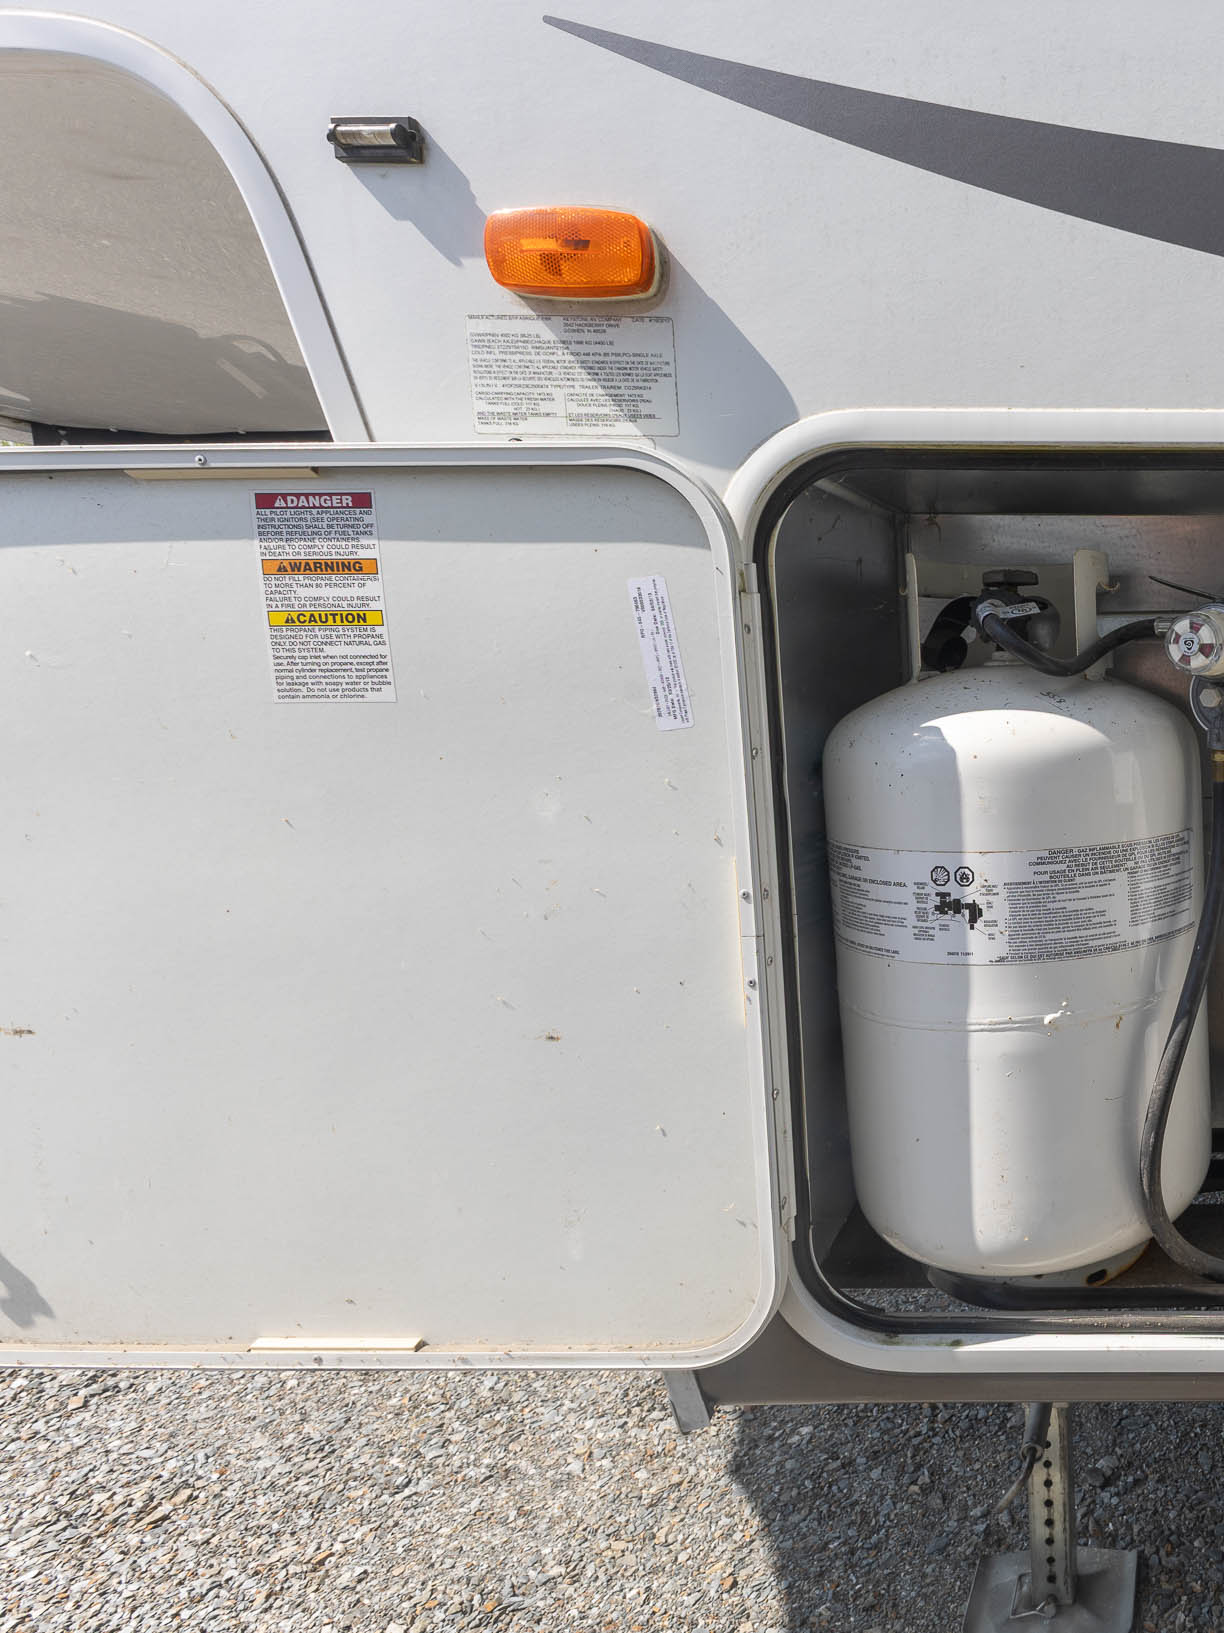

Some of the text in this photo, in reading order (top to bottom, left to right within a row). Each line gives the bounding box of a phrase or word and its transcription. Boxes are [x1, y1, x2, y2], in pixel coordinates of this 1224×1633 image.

[287, 496, 352, 507] DANGER
[288, 561, 363, 572] WARNING
[297, 613, 367, 623] CAUTION
